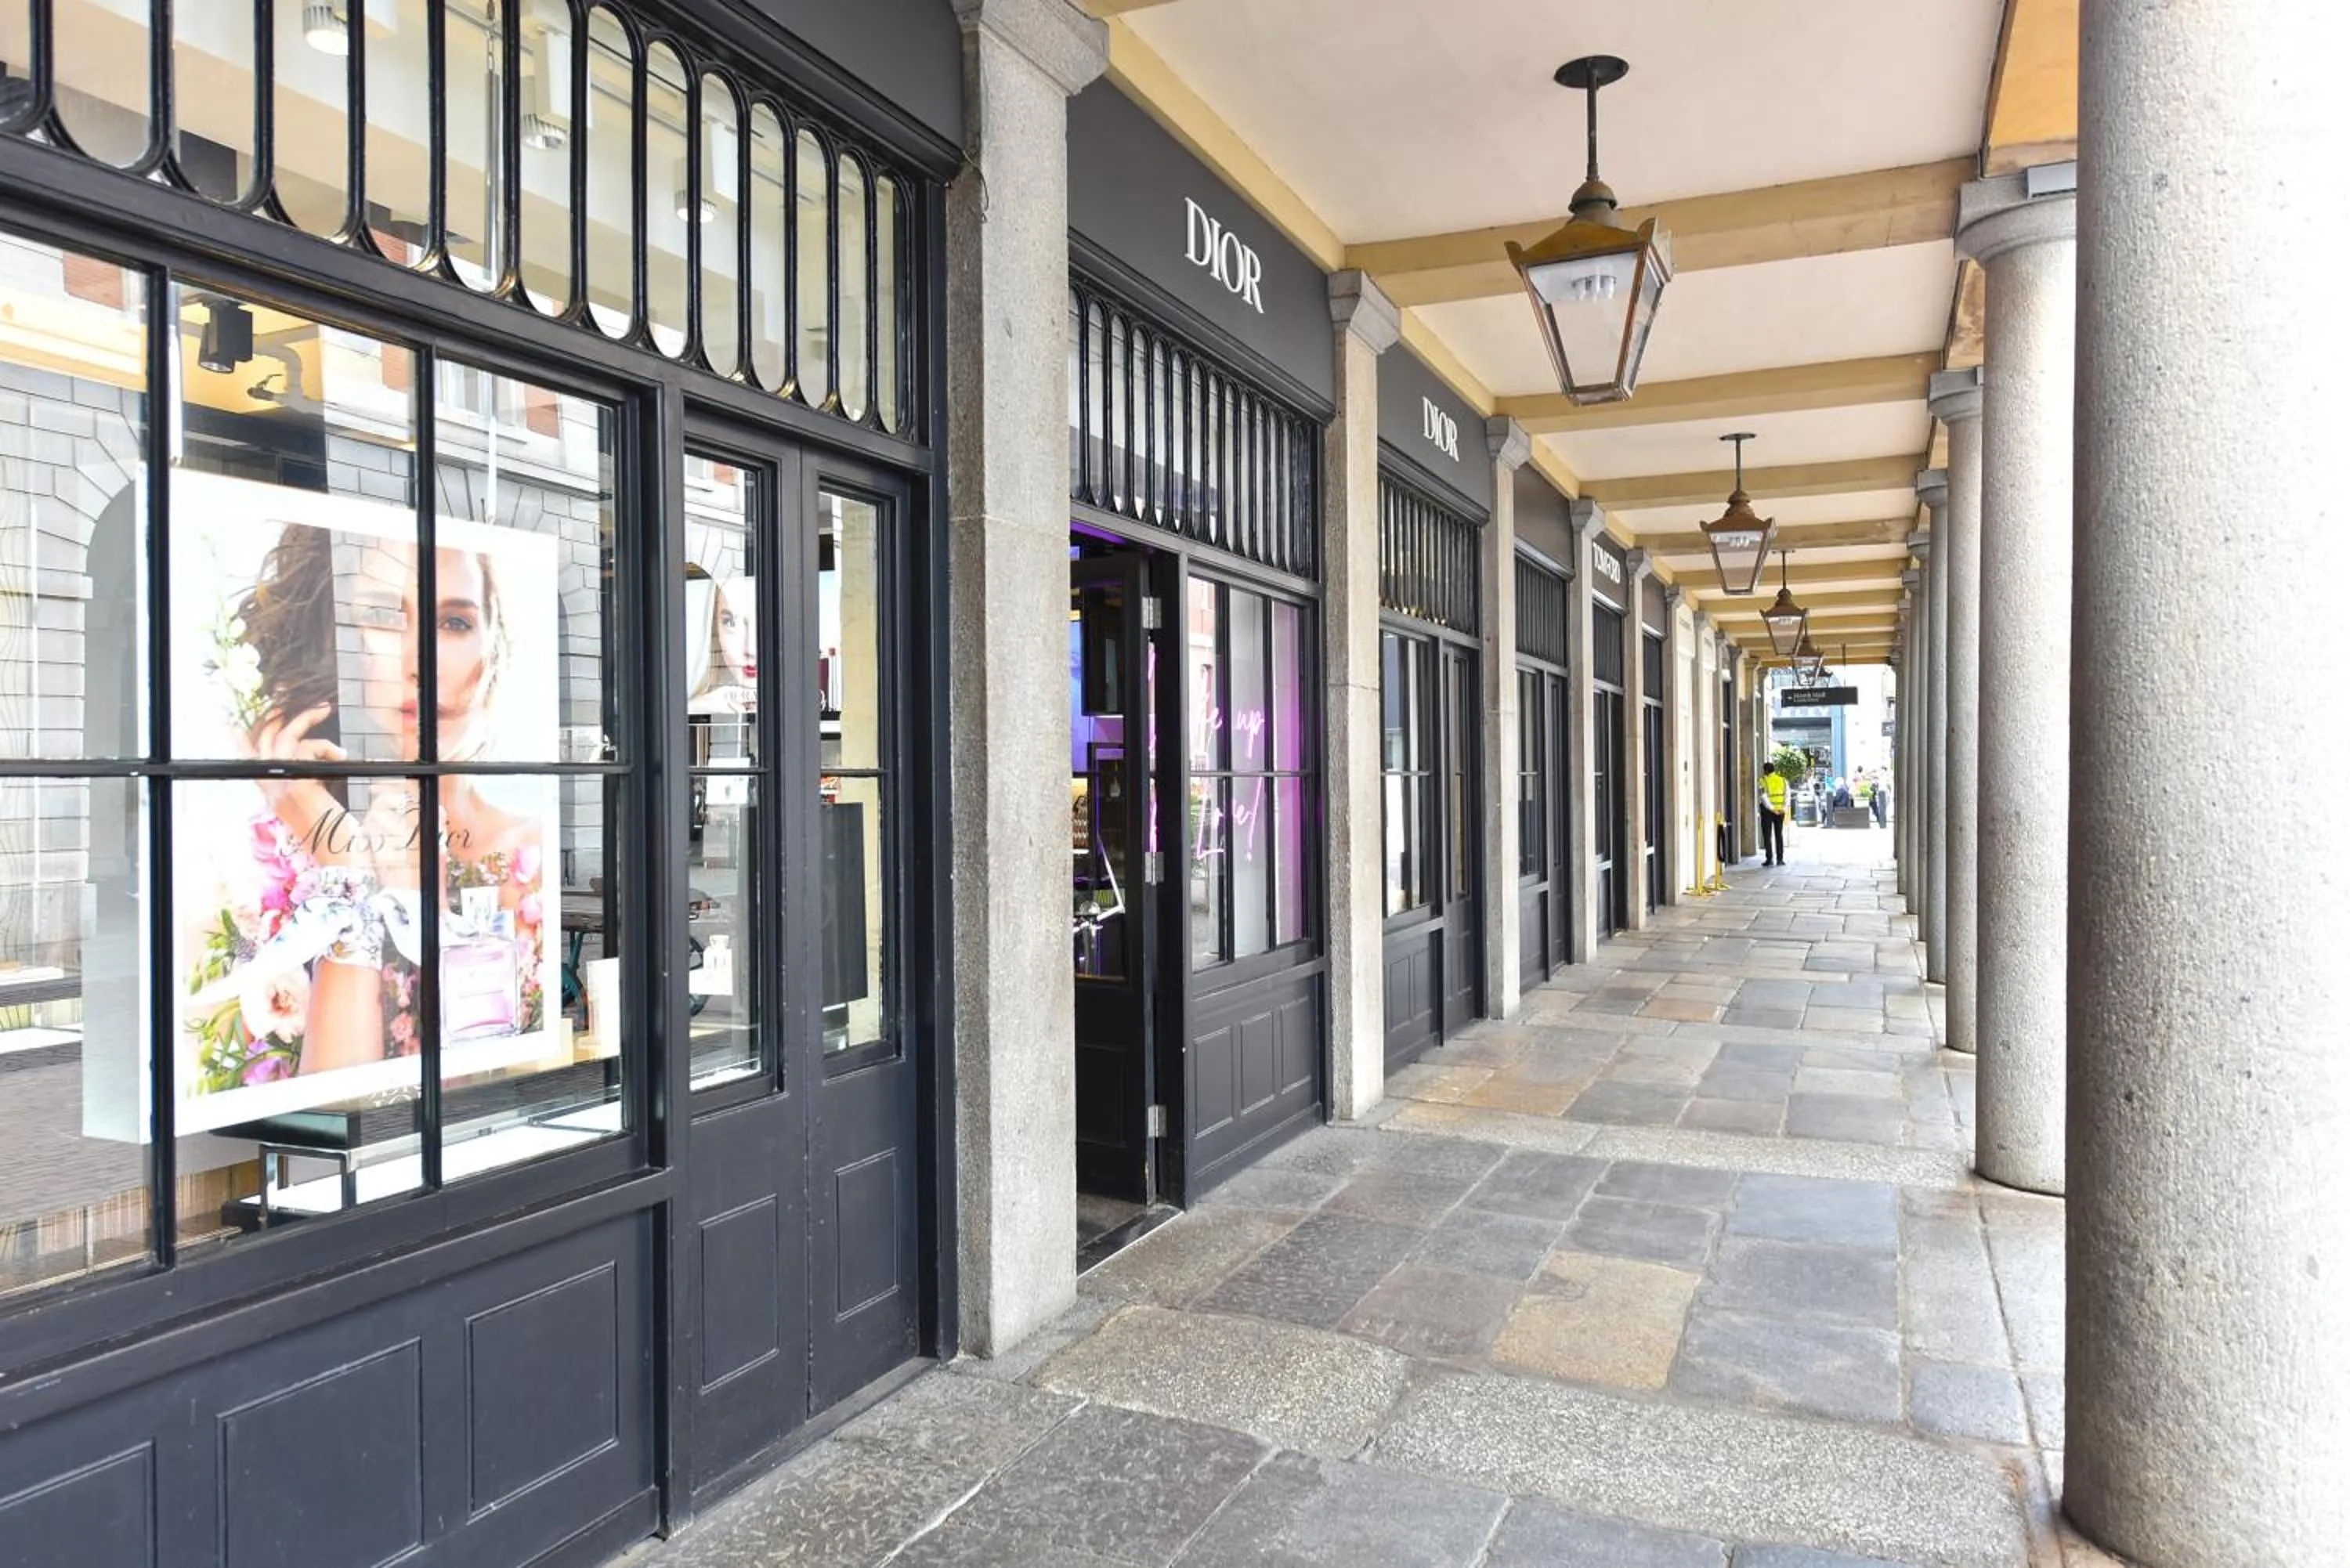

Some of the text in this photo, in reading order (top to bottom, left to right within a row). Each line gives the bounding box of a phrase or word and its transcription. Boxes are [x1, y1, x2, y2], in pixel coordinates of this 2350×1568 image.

[1184, 197, 1264, 314] DIOR
[1422, 395, 1459, 462] DIOR
[1235, 710, 1264, 759] up
[290, 807, 386, 854] Miss
